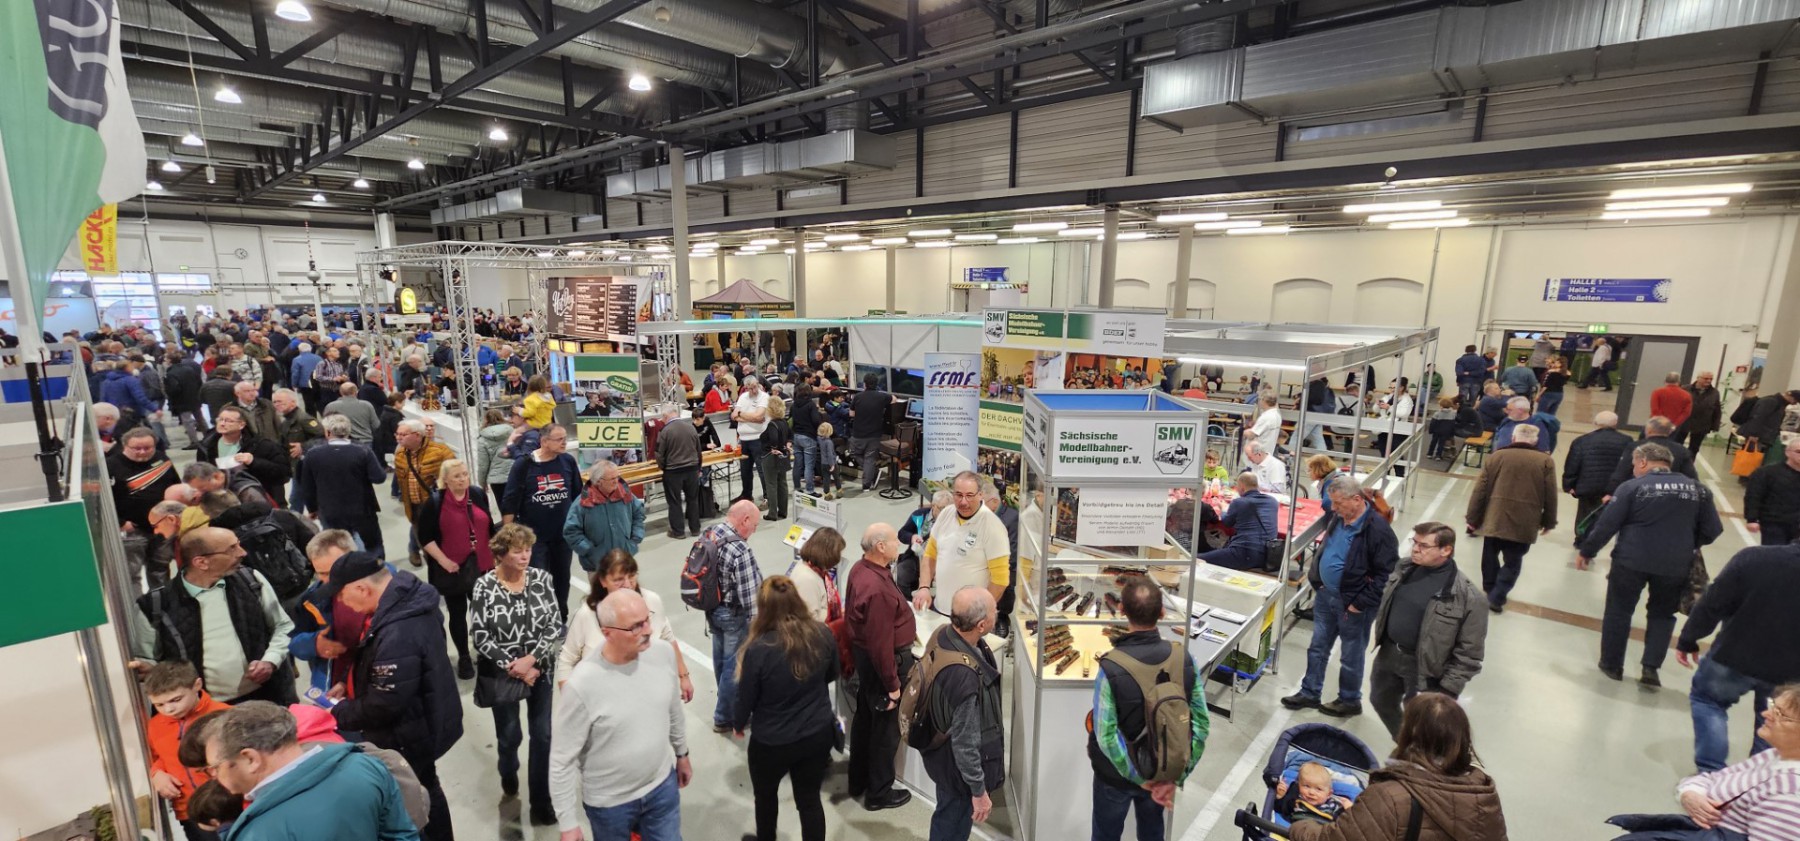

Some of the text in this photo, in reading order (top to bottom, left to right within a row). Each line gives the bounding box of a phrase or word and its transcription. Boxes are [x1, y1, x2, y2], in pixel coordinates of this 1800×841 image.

[987, 312, 1004, 322] SMV
[929, 371, 976, 386] FFMF
[981, 412, 996, 420] DER
[589, 425, 630, 441] JCE
[1060, 431, 1118, 440] Sächsische
[1158, 426, 1194, 440] SMV
[1059, 443, 1133, 452] Modellbahner-
[1059, 455, 1142, 465] Vereinigung e.V.
[1655, 483, 1697, 491] NAUTIC
[532, 491, 568, 503] NORWAY
